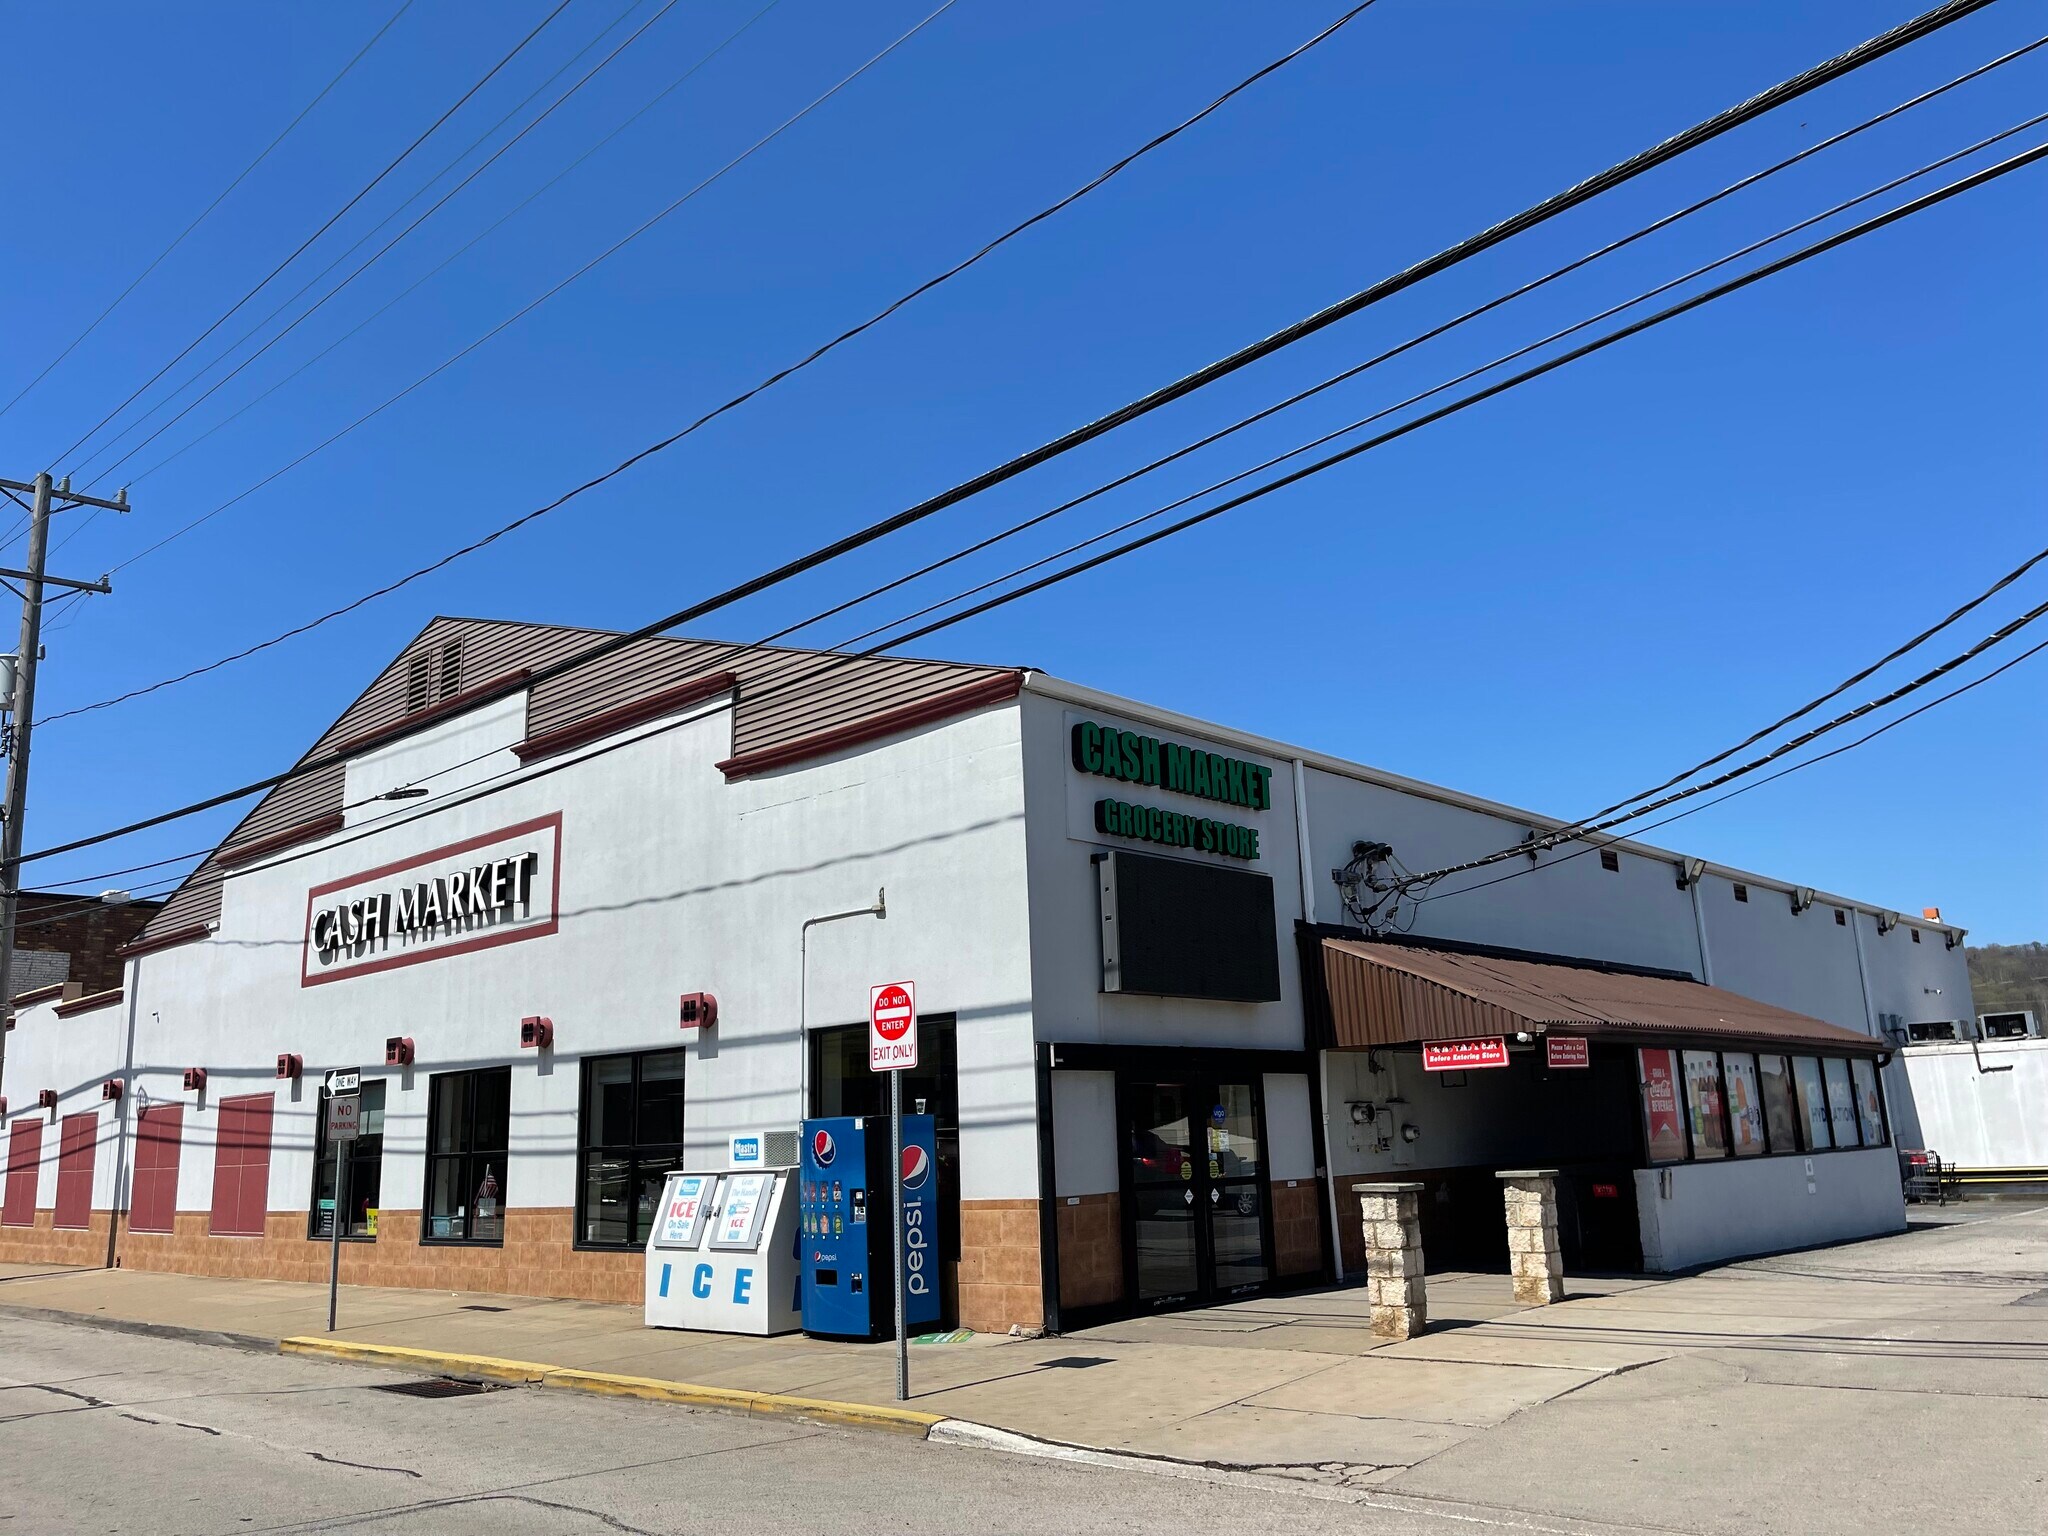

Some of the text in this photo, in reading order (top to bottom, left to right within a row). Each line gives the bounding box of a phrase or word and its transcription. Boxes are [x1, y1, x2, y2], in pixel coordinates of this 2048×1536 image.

[1073, 721, 1272, 810] CASH MARKET
[1096, 798, 1260, 859] GROCERY STORE
[310, 852, 536, 953] CASH MARKET
[879, 995, 907, 1007] DO NOT
[881, 1020, 904, 1031] ENTER
[873, 1044, 913, 1061] EXIT ONLY
[1429, 1055, 1451, 1063] Before
[1453, 1053, 1480, 1061] Entering
[335, 1075, 357, 1088] ONE WAY
[337, 1104, 352, 1117] NO
[1651, 1100, 1674, 1112] BEVERAGE
[330, 1121, 357, 1131] PARKING
[669, 1201, 698, 1218] ICE
[668, 1220, 689, 1229] On Sale
[730, 1219, 745, 1228] ICE
[670, 1231, 683, 1240] Here
[904, 1201, 929, 1295] pepsi
